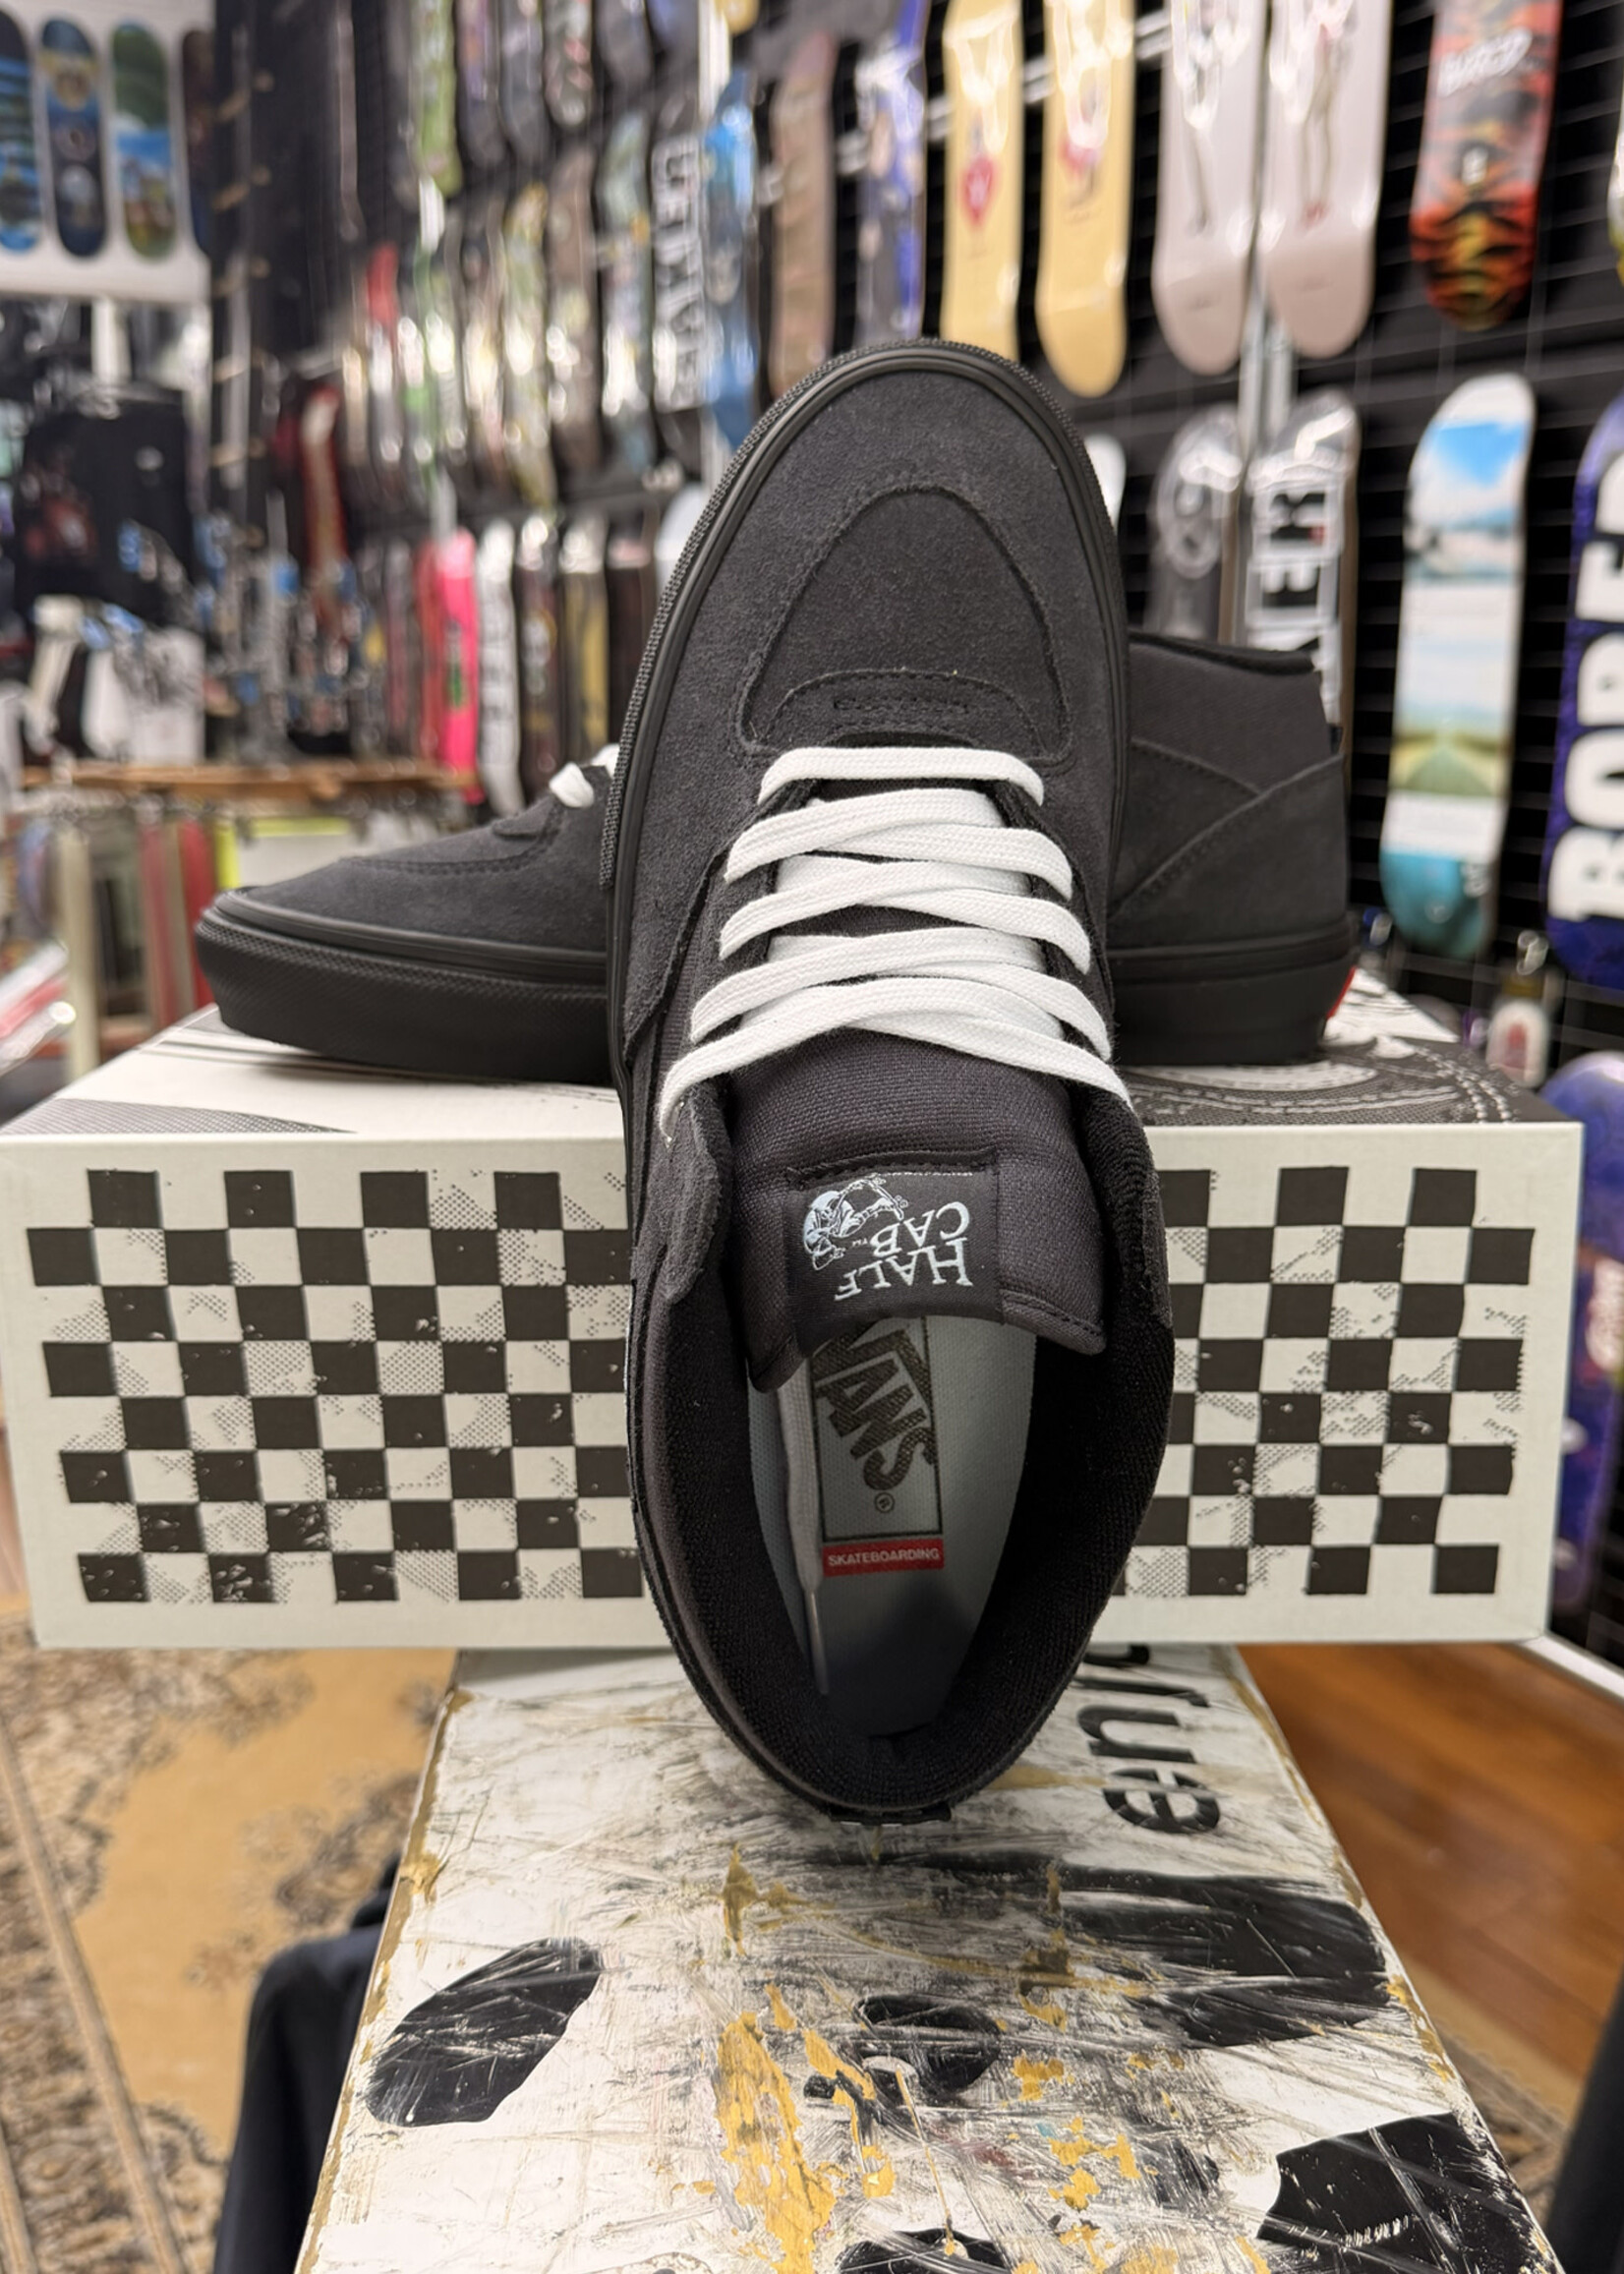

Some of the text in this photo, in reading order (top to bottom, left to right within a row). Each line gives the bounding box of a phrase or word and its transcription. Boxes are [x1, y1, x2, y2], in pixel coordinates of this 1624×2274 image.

[870, 1201, 971, 1257] CAB
[835, 1237, 973, 1301] HALF
[811, 1328, 937, 1490] VANS
[828, 1547, 941, 1568] SKATEBOARDING
